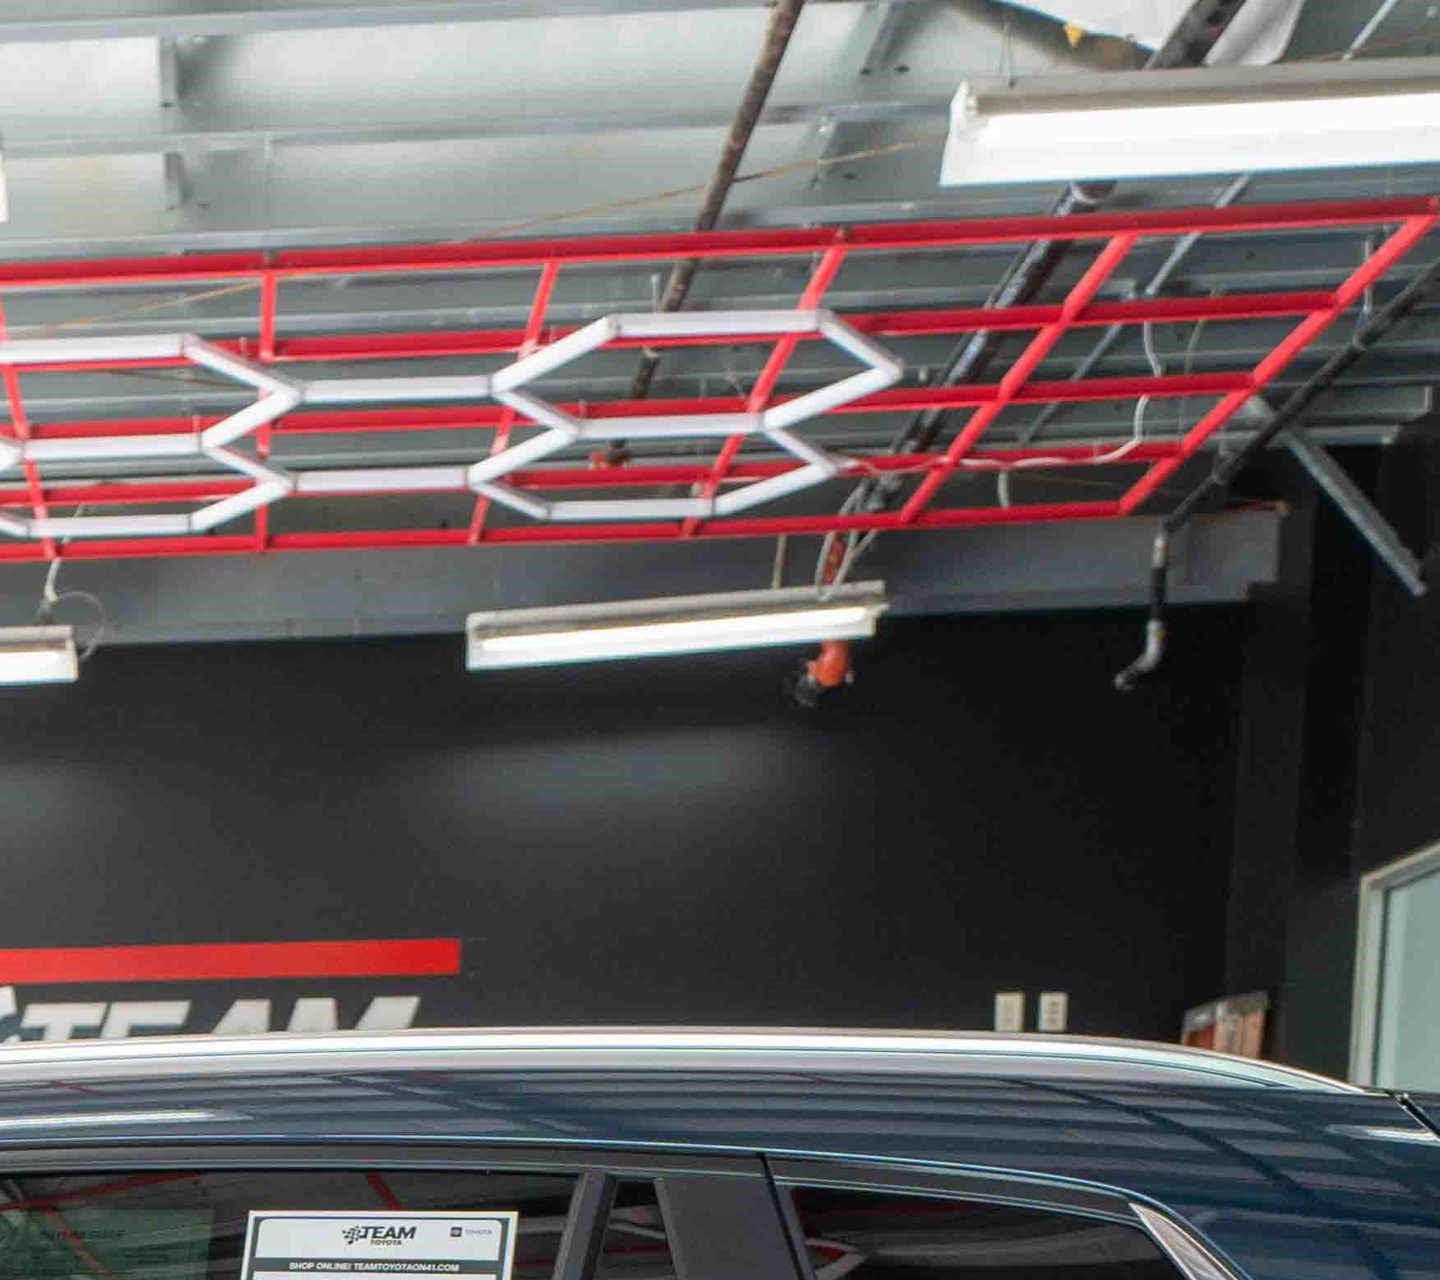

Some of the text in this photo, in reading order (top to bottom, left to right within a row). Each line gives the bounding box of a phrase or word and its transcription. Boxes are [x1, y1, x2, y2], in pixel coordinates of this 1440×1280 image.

[364, 1225, 417, 1240] TEAM
[289, 1261, 314, 1271] SHOP
[316, 1262, 352, 1271] ONLINE!
